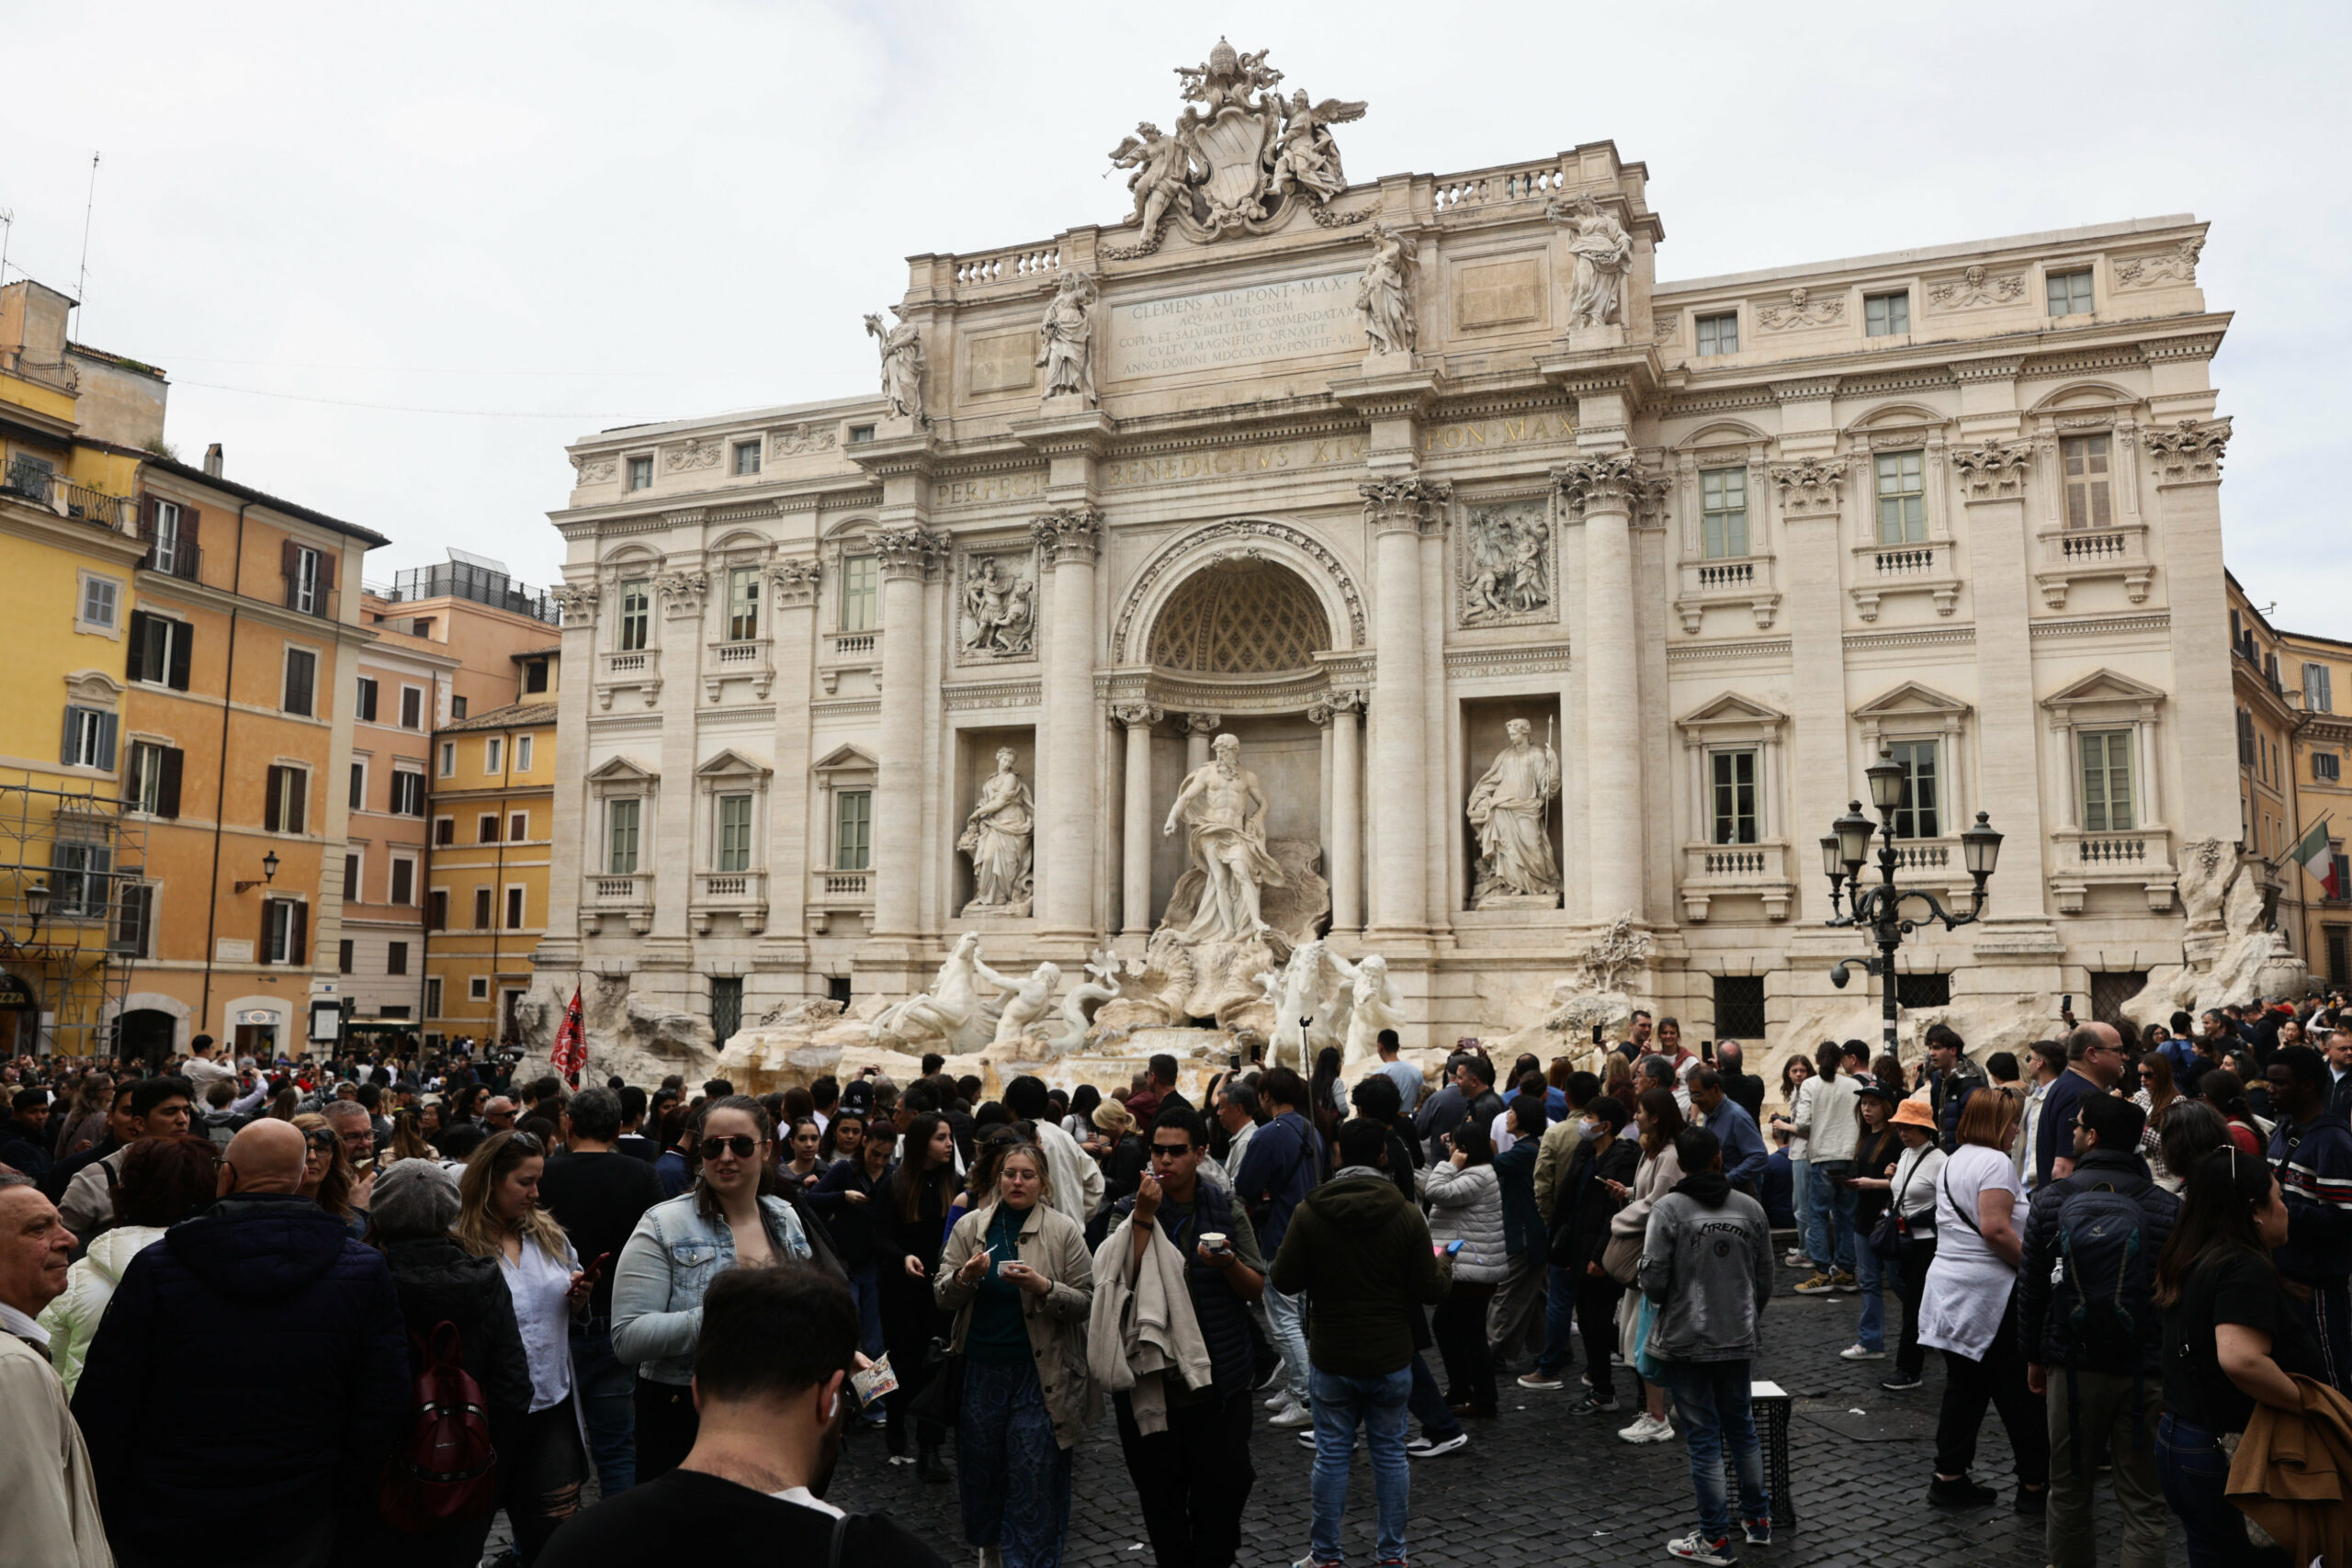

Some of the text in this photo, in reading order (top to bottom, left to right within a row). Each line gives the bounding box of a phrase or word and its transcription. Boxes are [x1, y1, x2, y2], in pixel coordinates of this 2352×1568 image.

[1132, 299, 1203, 320] CLEMENS
[1231, 300, 1294, 319] VIRGINEM
[1118, 334, 1153, 348] COPIA
[1158, 332, 1170, 343] ET
[1148, 322, 1328, 357] CVLTV MAGNIFICO ORNAVIT
[1123, 360, 1159, 375] ANNO
[1161, 353, 1207, 369] DOMINI
[1109, 446, 1290, 487] BENEDICTVS
